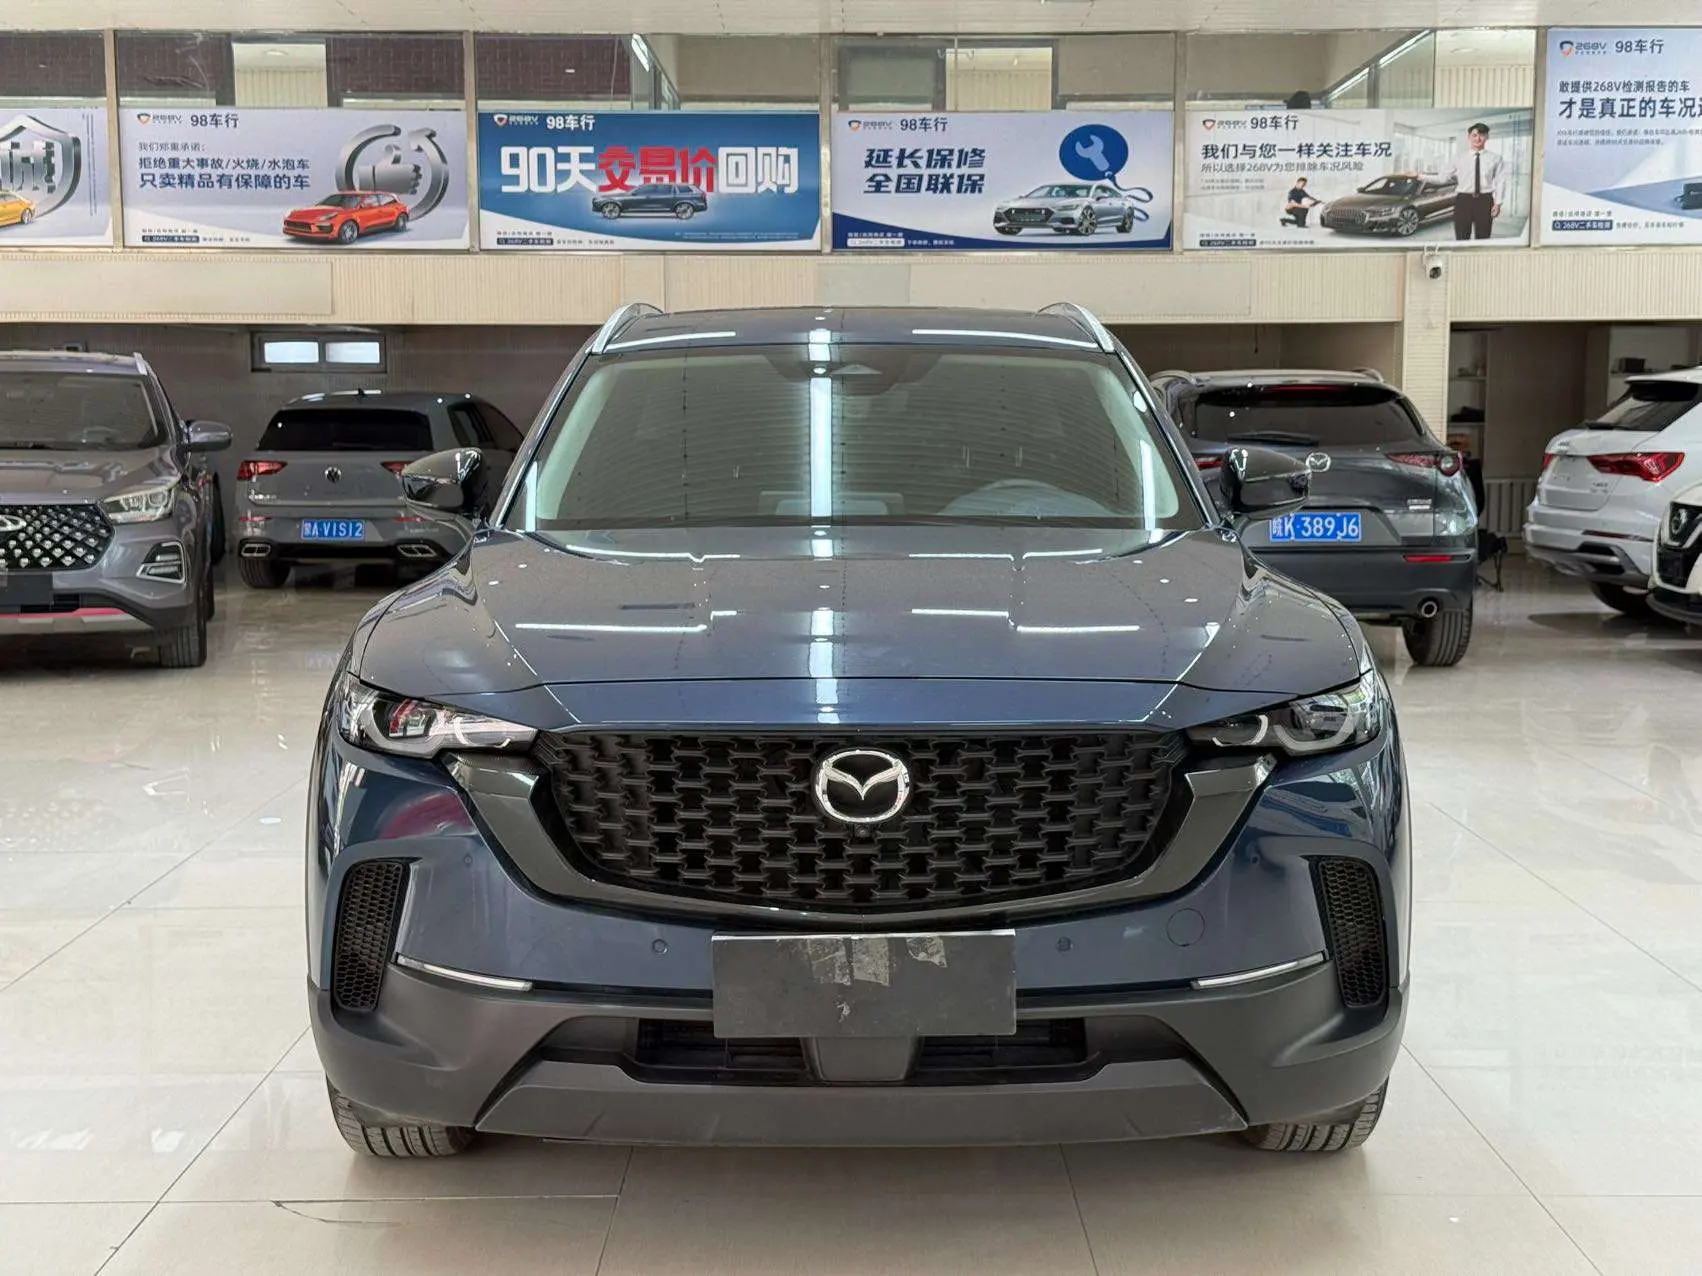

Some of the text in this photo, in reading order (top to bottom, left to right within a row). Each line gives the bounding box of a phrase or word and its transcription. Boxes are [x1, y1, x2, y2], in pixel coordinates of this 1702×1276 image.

[1615, 39, 1664, 54] 98车行
[1558, 80, 1691, 94] 敢提供268V检测报告的车
[190, 113, 239, 128] 98车行
[546, 115, 595, 131] 98车行
[900, 117, 948, 132] 98车行
[1250, 115, 1298, 131] 98车行
[865, 148, 986, 169] 延长保修
[1201, 141, 1392, 160] 我们与您一样关注车况
[139, 157, 310, 171] 拒绝重大事故/火烧/水泡车
[501, 146, 799, 193] 90天交易价回购
[140, 173, 311, 190] 只卖精品有保障的车
[864, 173, 985, 194] 全国联保
